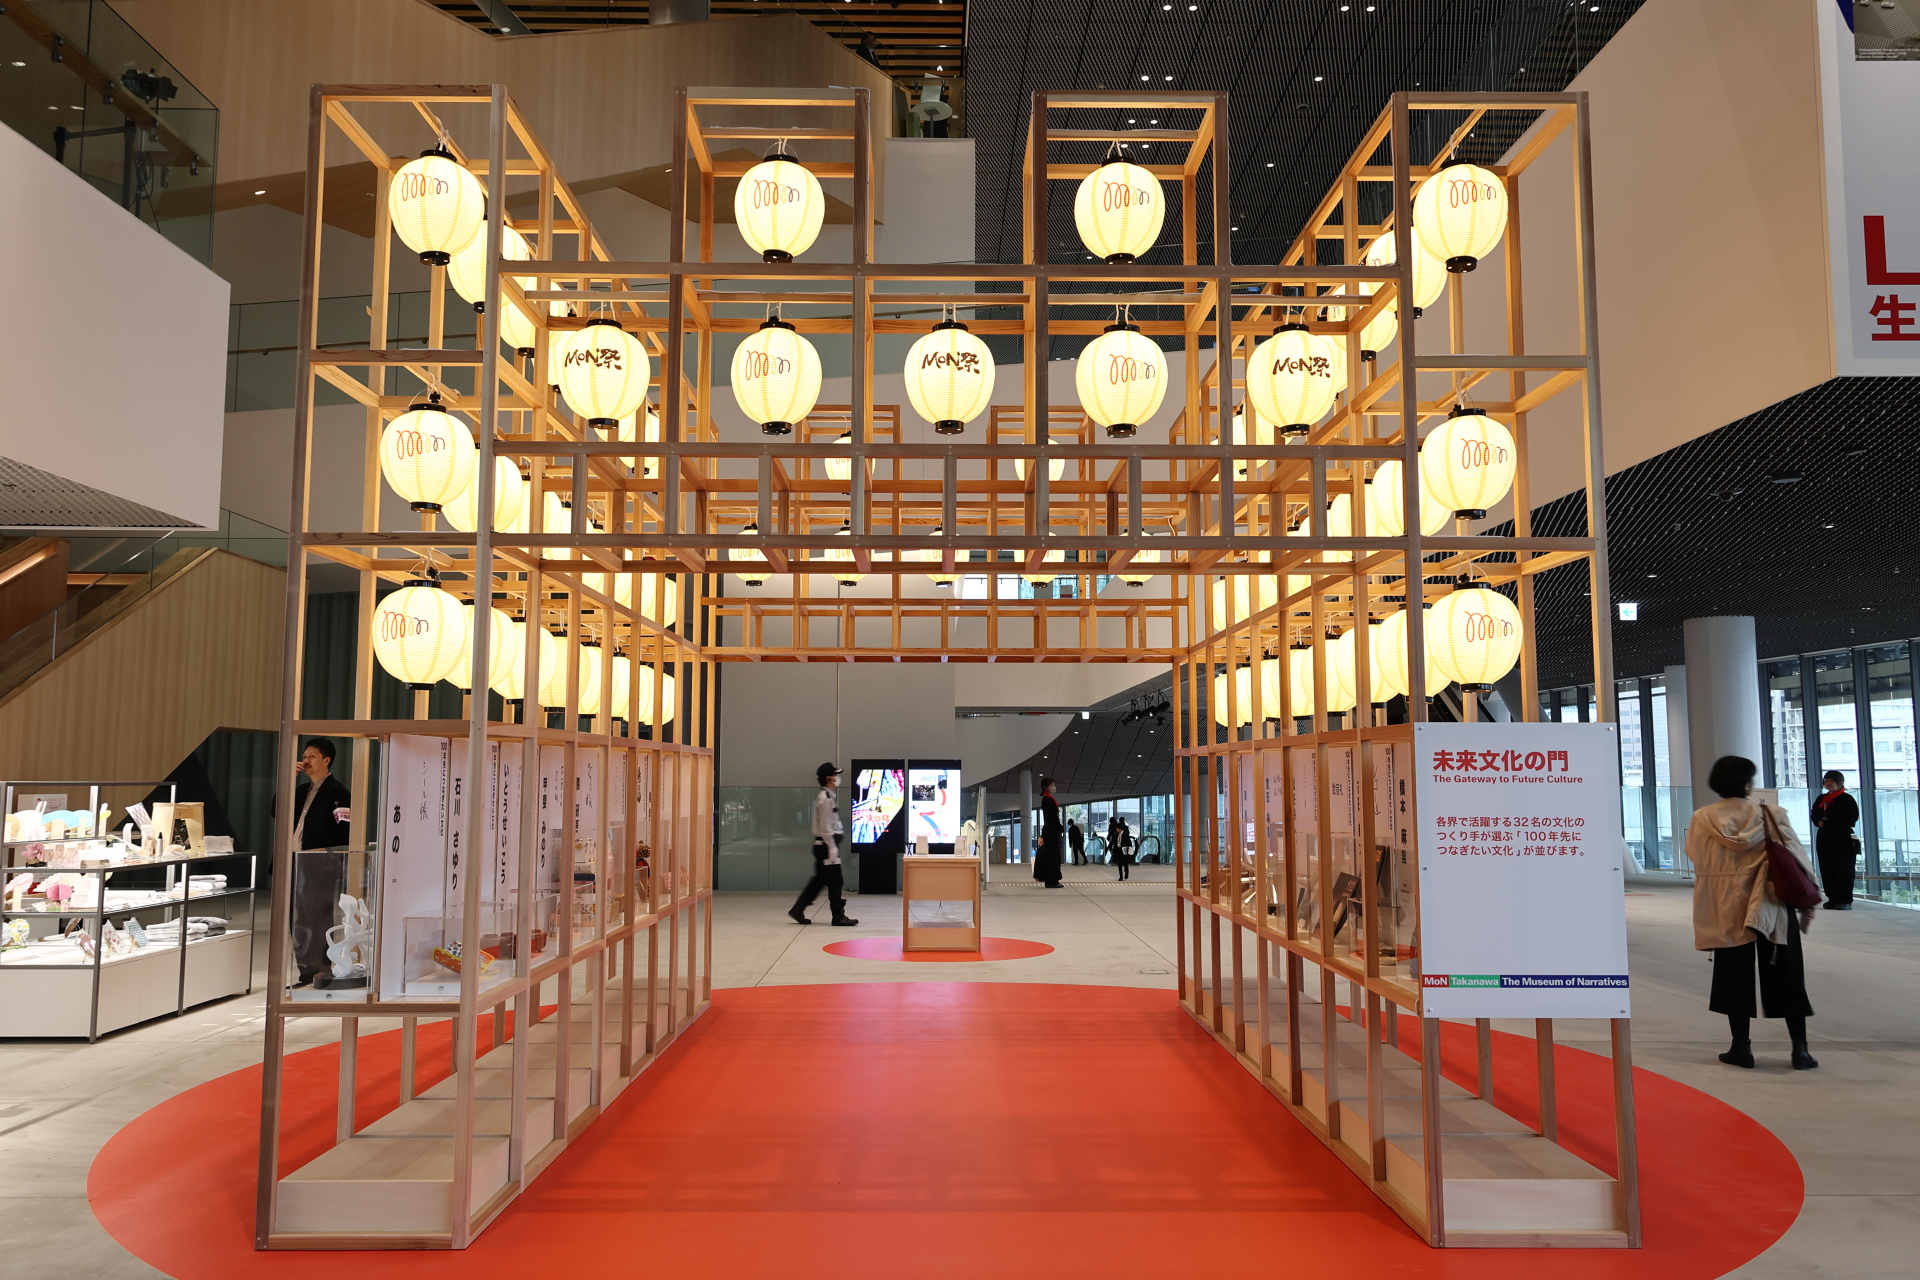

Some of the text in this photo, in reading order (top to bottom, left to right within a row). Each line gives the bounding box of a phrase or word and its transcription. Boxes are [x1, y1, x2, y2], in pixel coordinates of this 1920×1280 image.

[1869, 294, 1920, 341] 生
[1433, 750, 1569, 772] 未来文化の門
[1433, 775, 1583, 785] The Gateway to Future Culture
[1436, 817, 1585, 827] 各界で活躍する32名の文化の
[392, 804, 401, 854] あの
[452, 778, 461, 890] 石川 さゆり
[1437, 831, 1582, 842] つくり手が選ぶ「100年先に
[1437, 845, 1585, 856] つなぎたい文化」が並びます。
[1424, 977, 1628, 987] MoN Takanawa The Museum of Narratives
